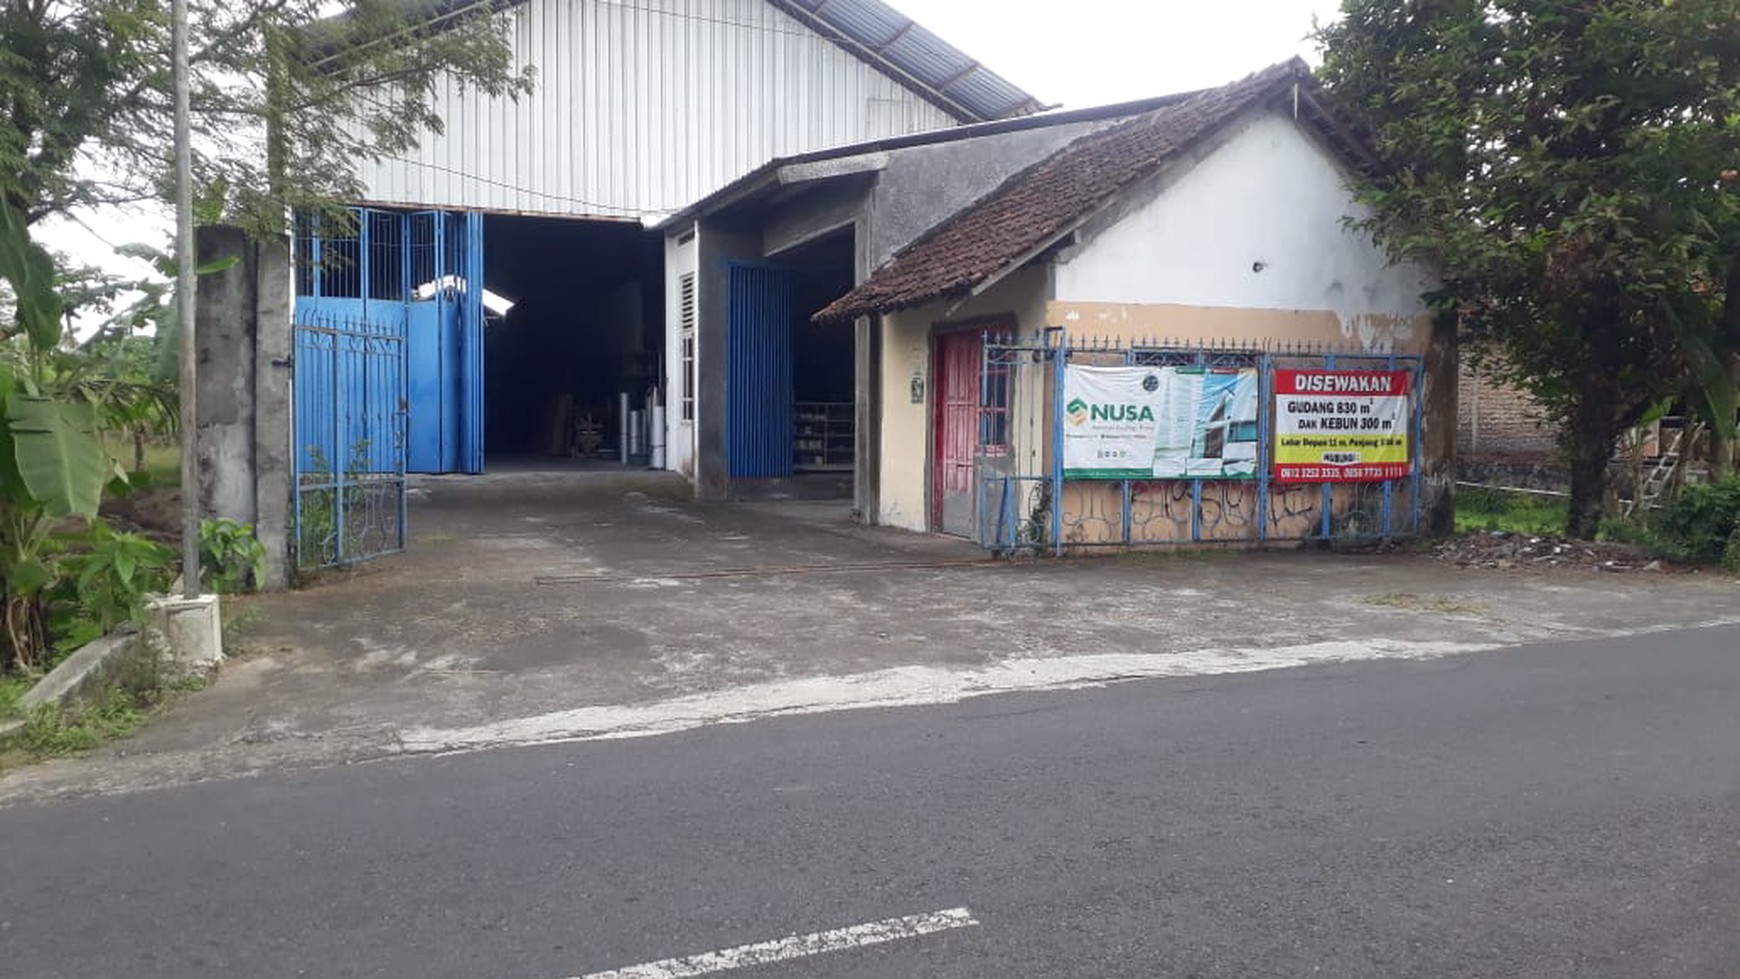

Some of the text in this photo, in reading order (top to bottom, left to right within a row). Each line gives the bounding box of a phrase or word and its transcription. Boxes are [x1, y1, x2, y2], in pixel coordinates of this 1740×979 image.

[1295, 373, 1392, 392] DISEWAKAN
[1090, 403, 1155, 422] NUSA
[1287, 401, 1335, 414] GUDANG
[1336, 401, 1357, 415] 830
[1320, 417, 1359, 430] KEBUN
[1360, 417, 1380, 430] 300
